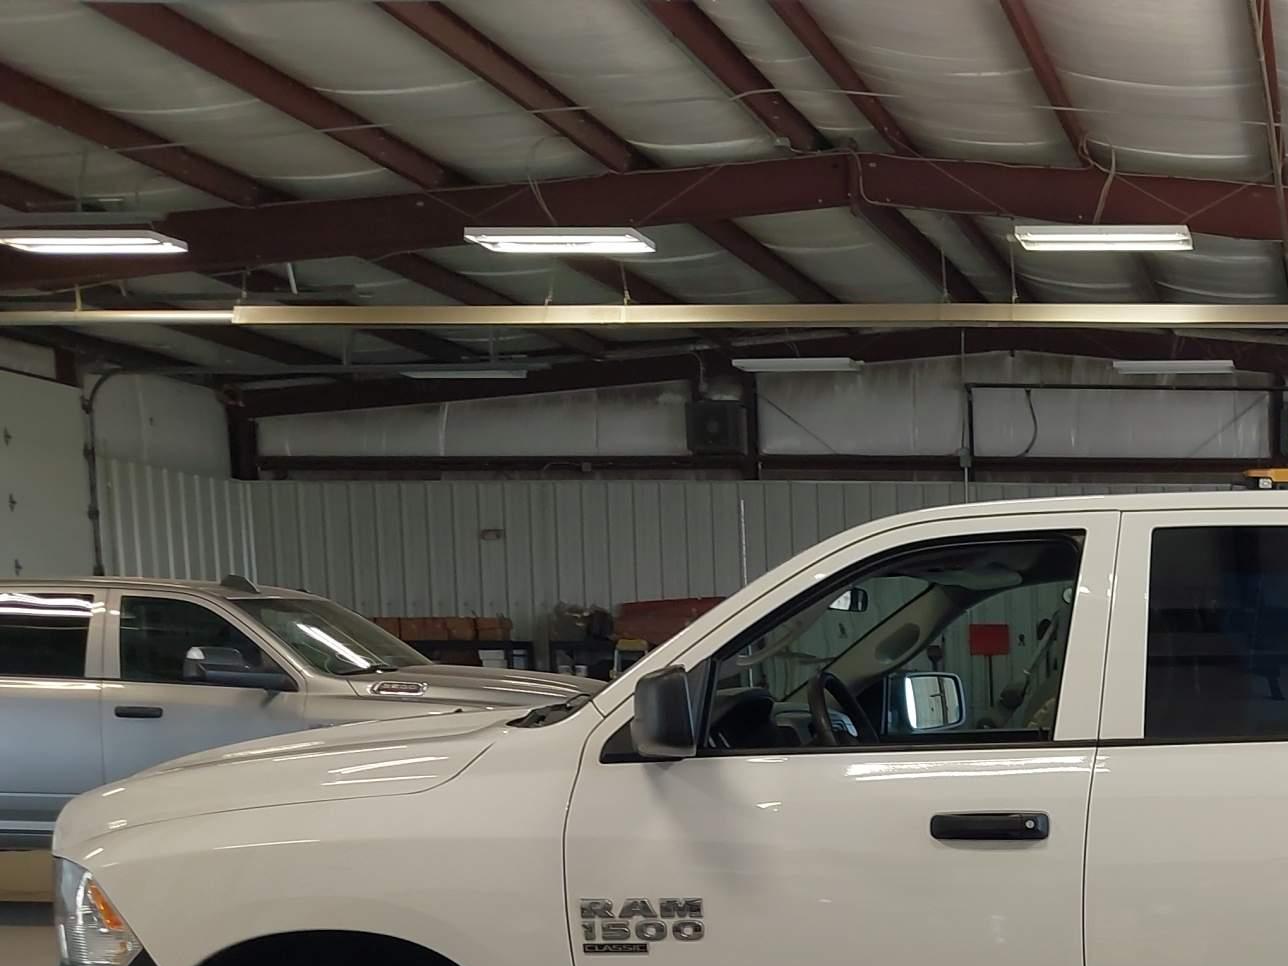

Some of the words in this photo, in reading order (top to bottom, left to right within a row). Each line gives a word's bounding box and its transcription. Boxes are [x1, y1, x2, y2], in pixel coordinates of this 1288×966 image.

[580, 897, 703, 918] RAM
[582, 920, 705, 941] 1500
[584, 944, 647, 952] CLASSIC
